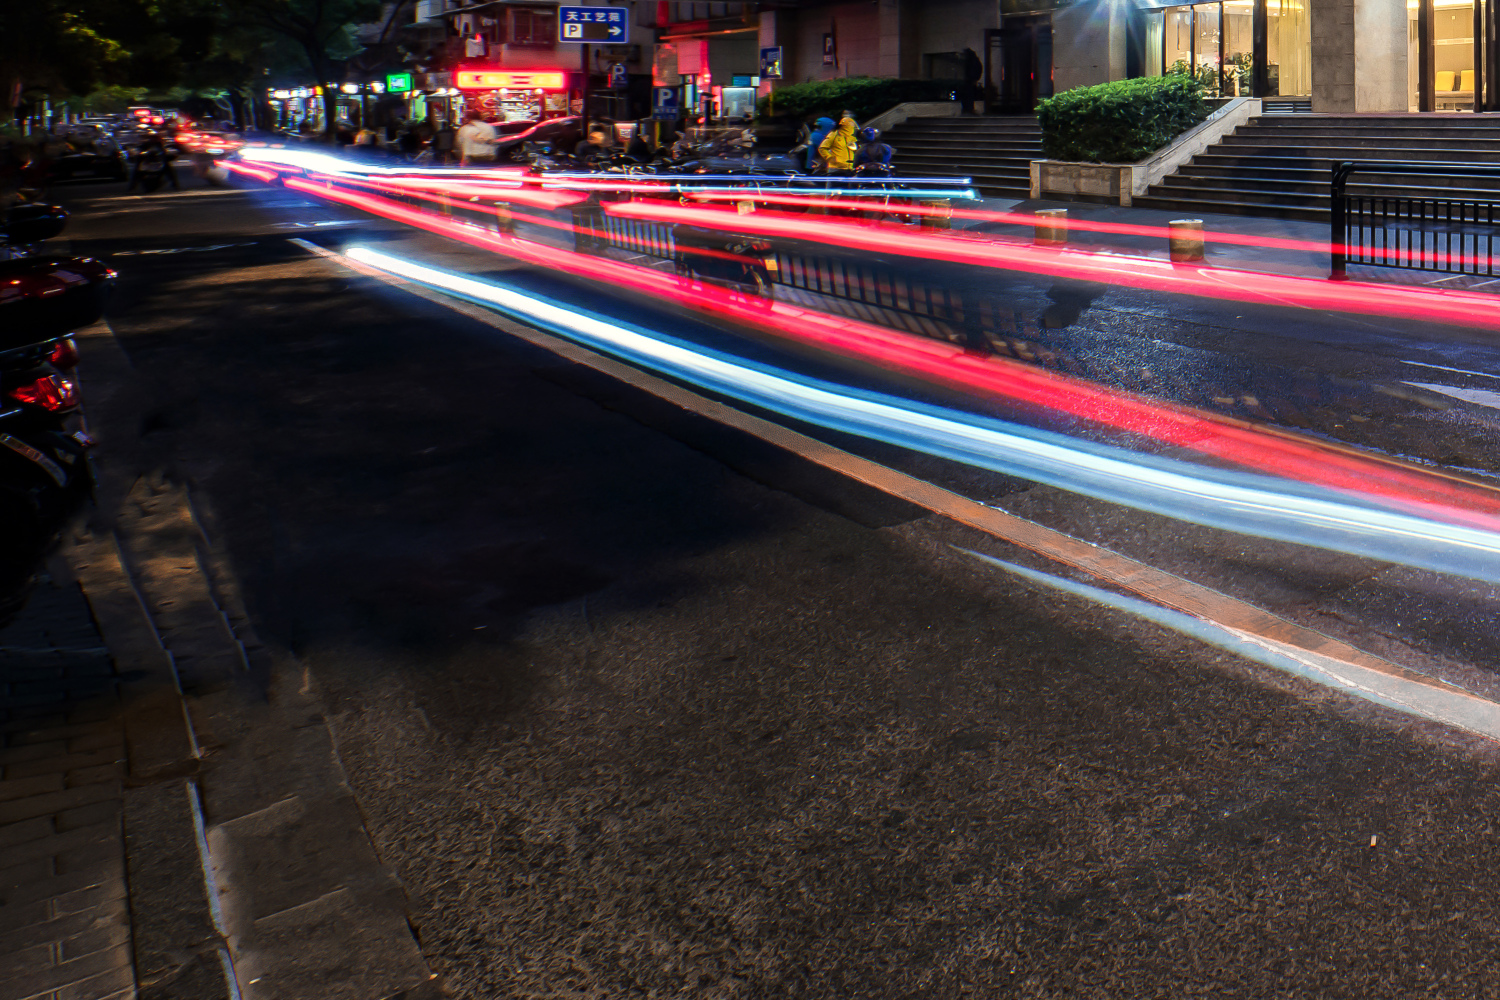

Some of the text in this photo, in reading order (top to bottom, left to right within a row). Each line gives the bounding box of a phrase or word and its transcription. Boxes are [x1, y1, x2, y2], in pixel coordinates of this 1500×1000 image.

[566, 11, 621, 22] 天工艺苑
[658, 88, 673, 107] P
